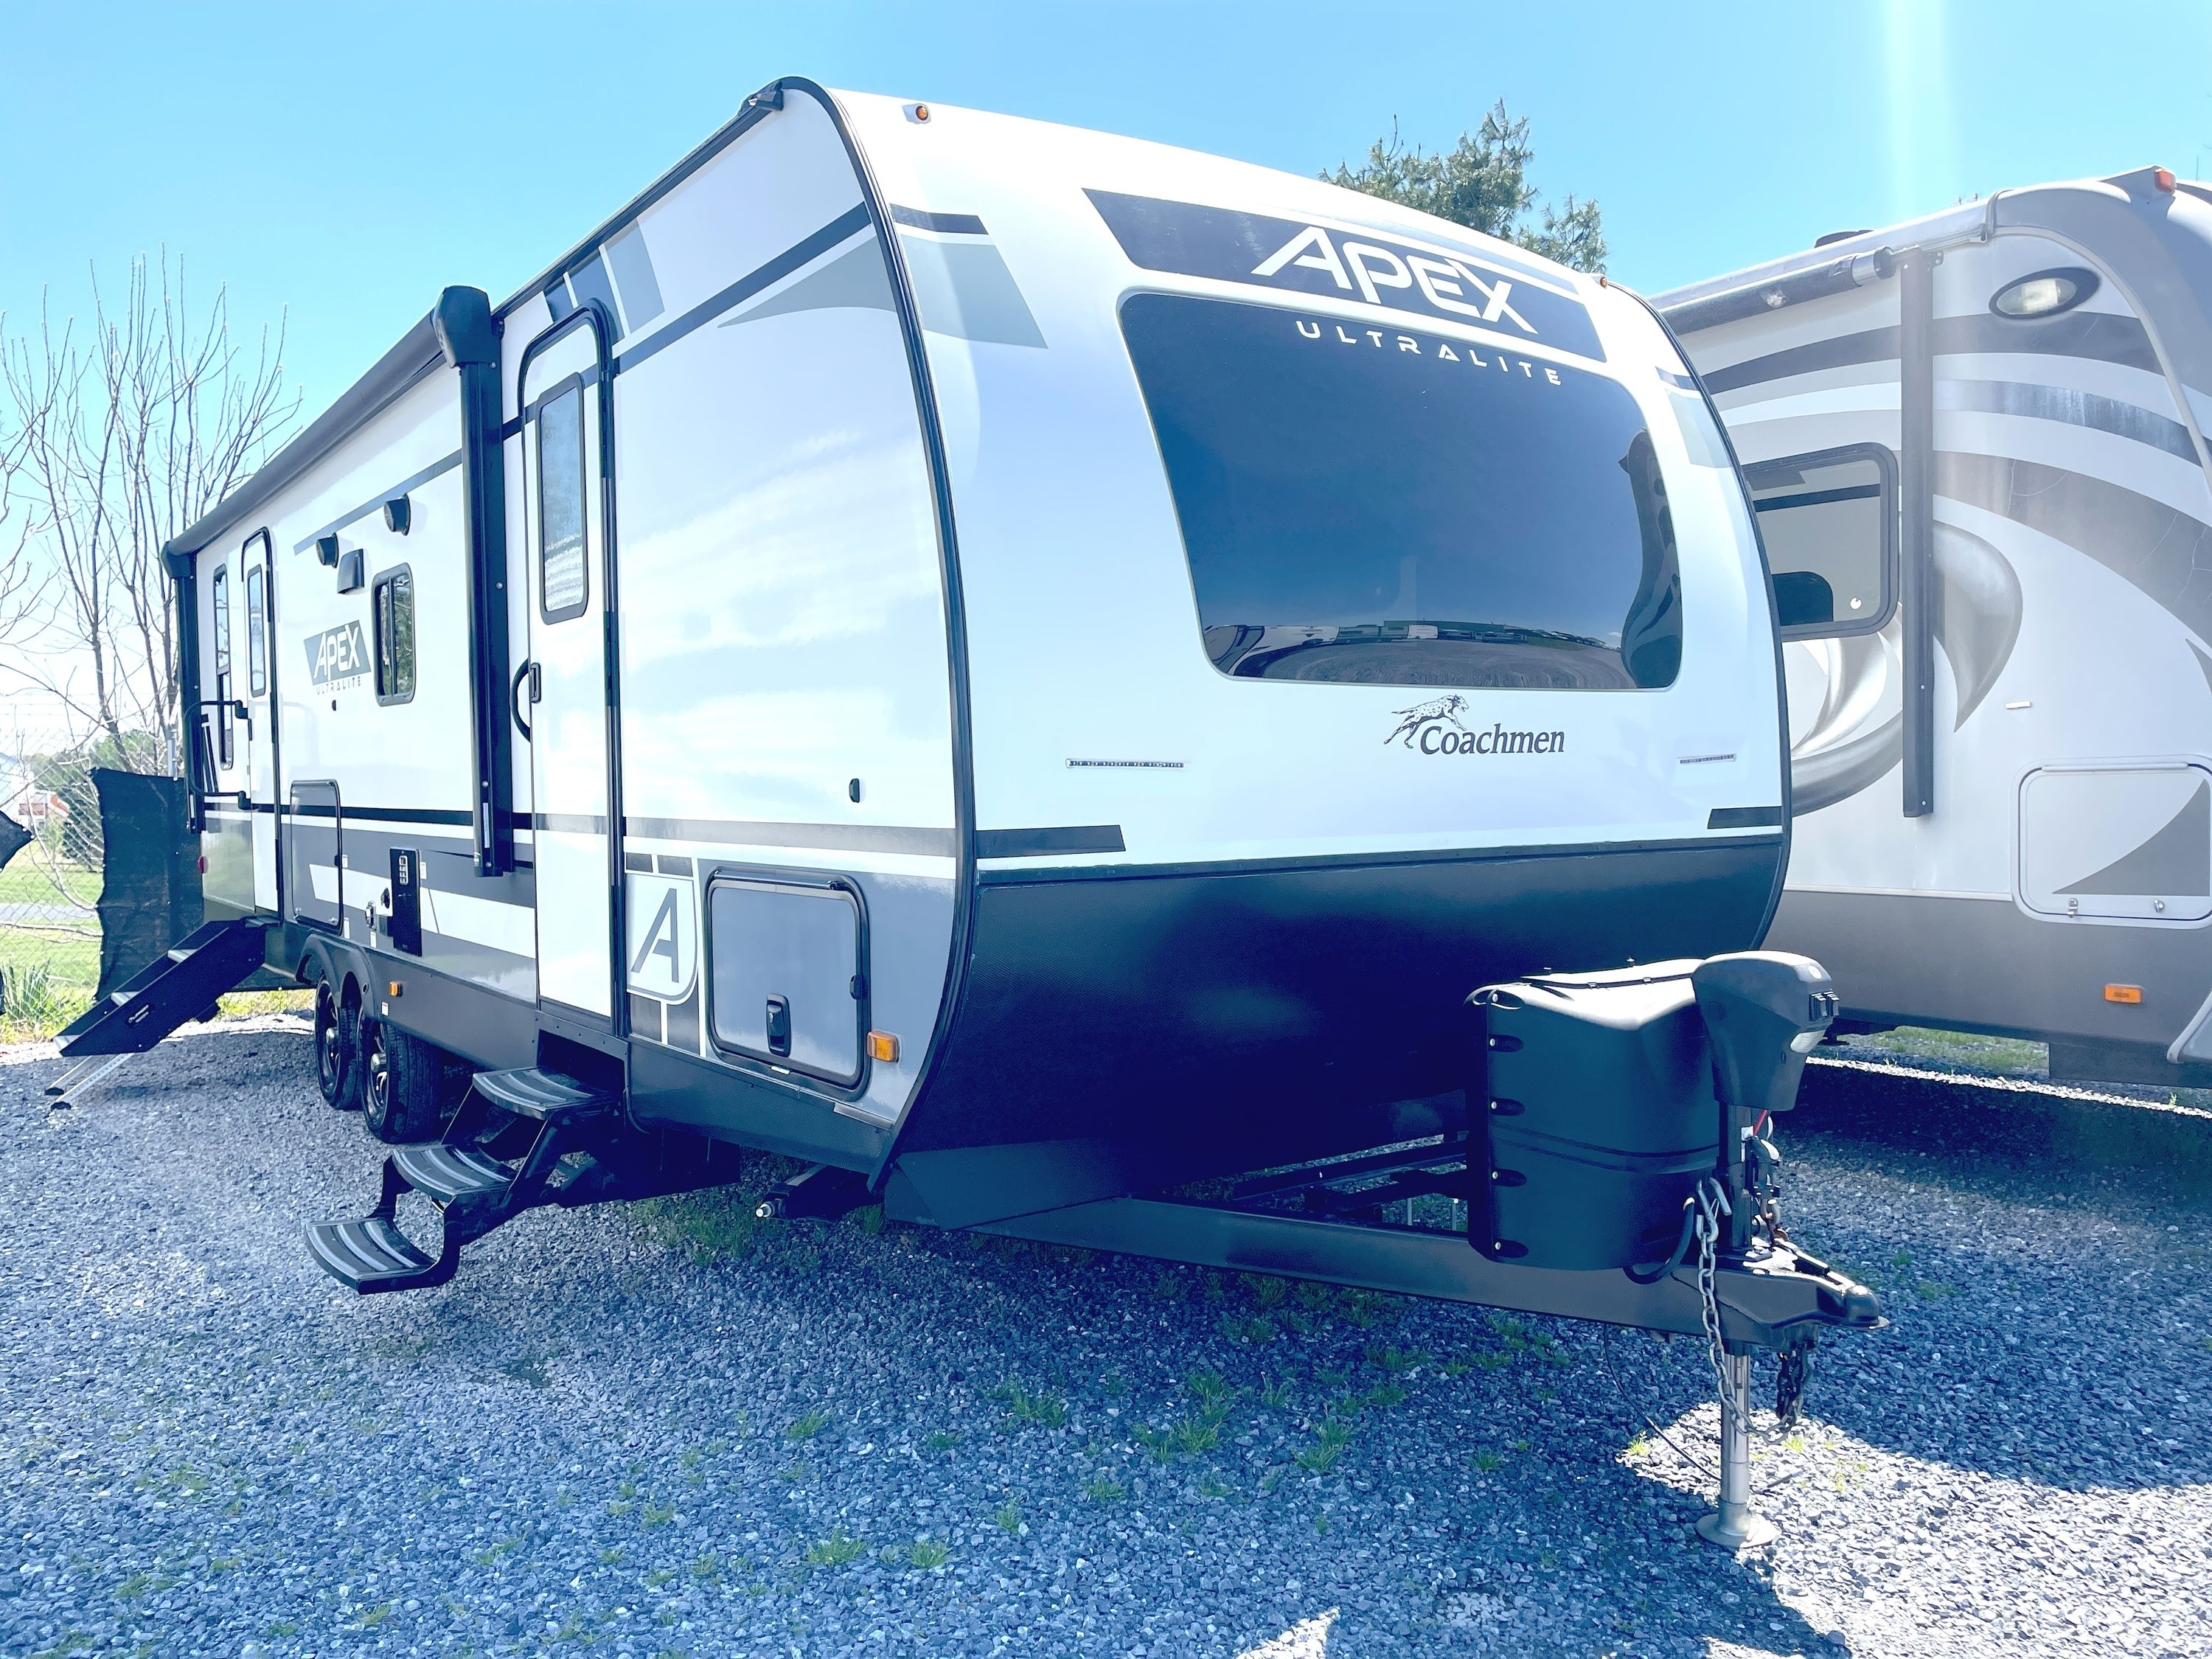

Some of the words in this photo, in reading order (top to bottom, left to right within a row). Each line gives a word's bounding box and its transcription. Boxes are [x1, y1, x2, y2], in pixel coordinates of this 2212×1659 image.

[1251, 226, 1539, 334] APEX
[1295, 321, 1562, 386] ULTRALITE
[313, 624, 360, 681] APEX
[316, 676, 361, 695] ULTRALITE
[1420, 723, 1565, 754] Coachmen
[630, 888, 679, 983] A
